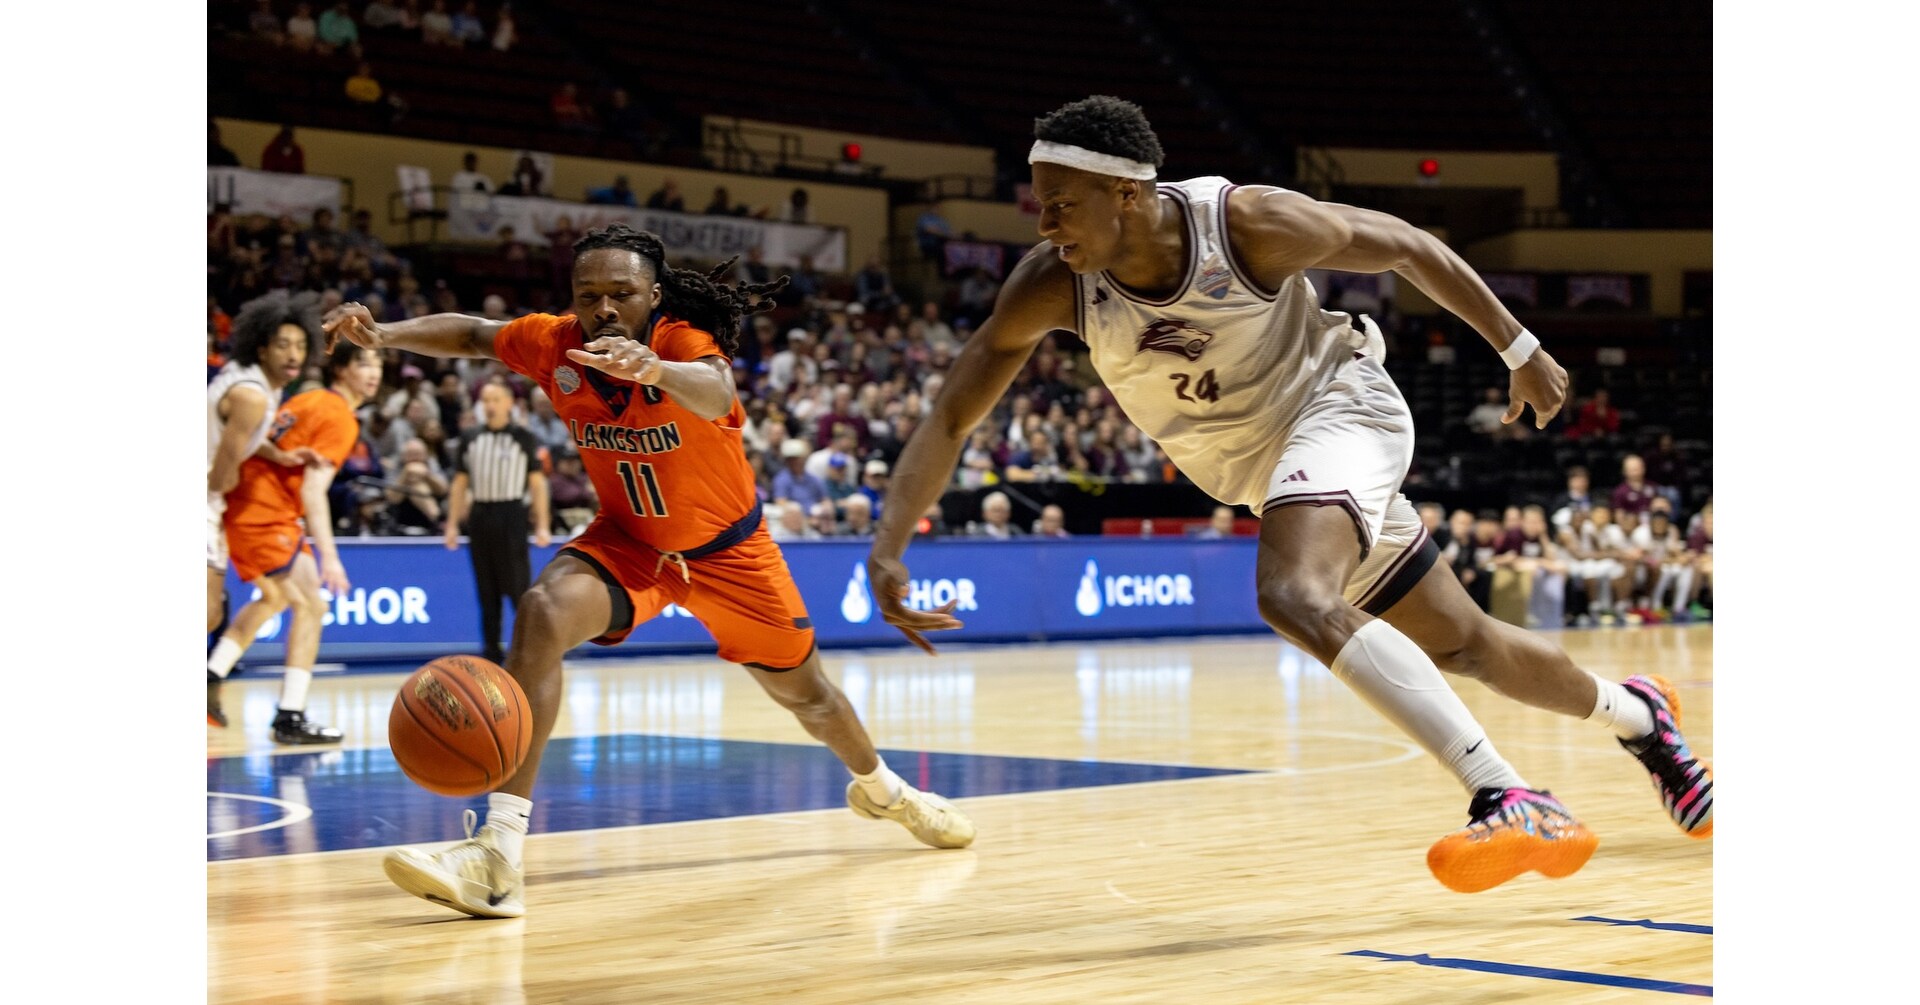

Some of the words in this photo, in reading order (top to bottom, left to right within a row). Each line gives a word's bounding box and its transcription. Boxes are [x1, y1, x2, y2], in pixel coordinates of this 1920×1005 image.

[1168, 368, 1220, 403] 24
[570, 418, 682, 455] LANGSTON
[616, 460, 669, 517] 11
[901, 578, 979, 611] HOR
[1105, 574, 1194, 606] ICHOR
